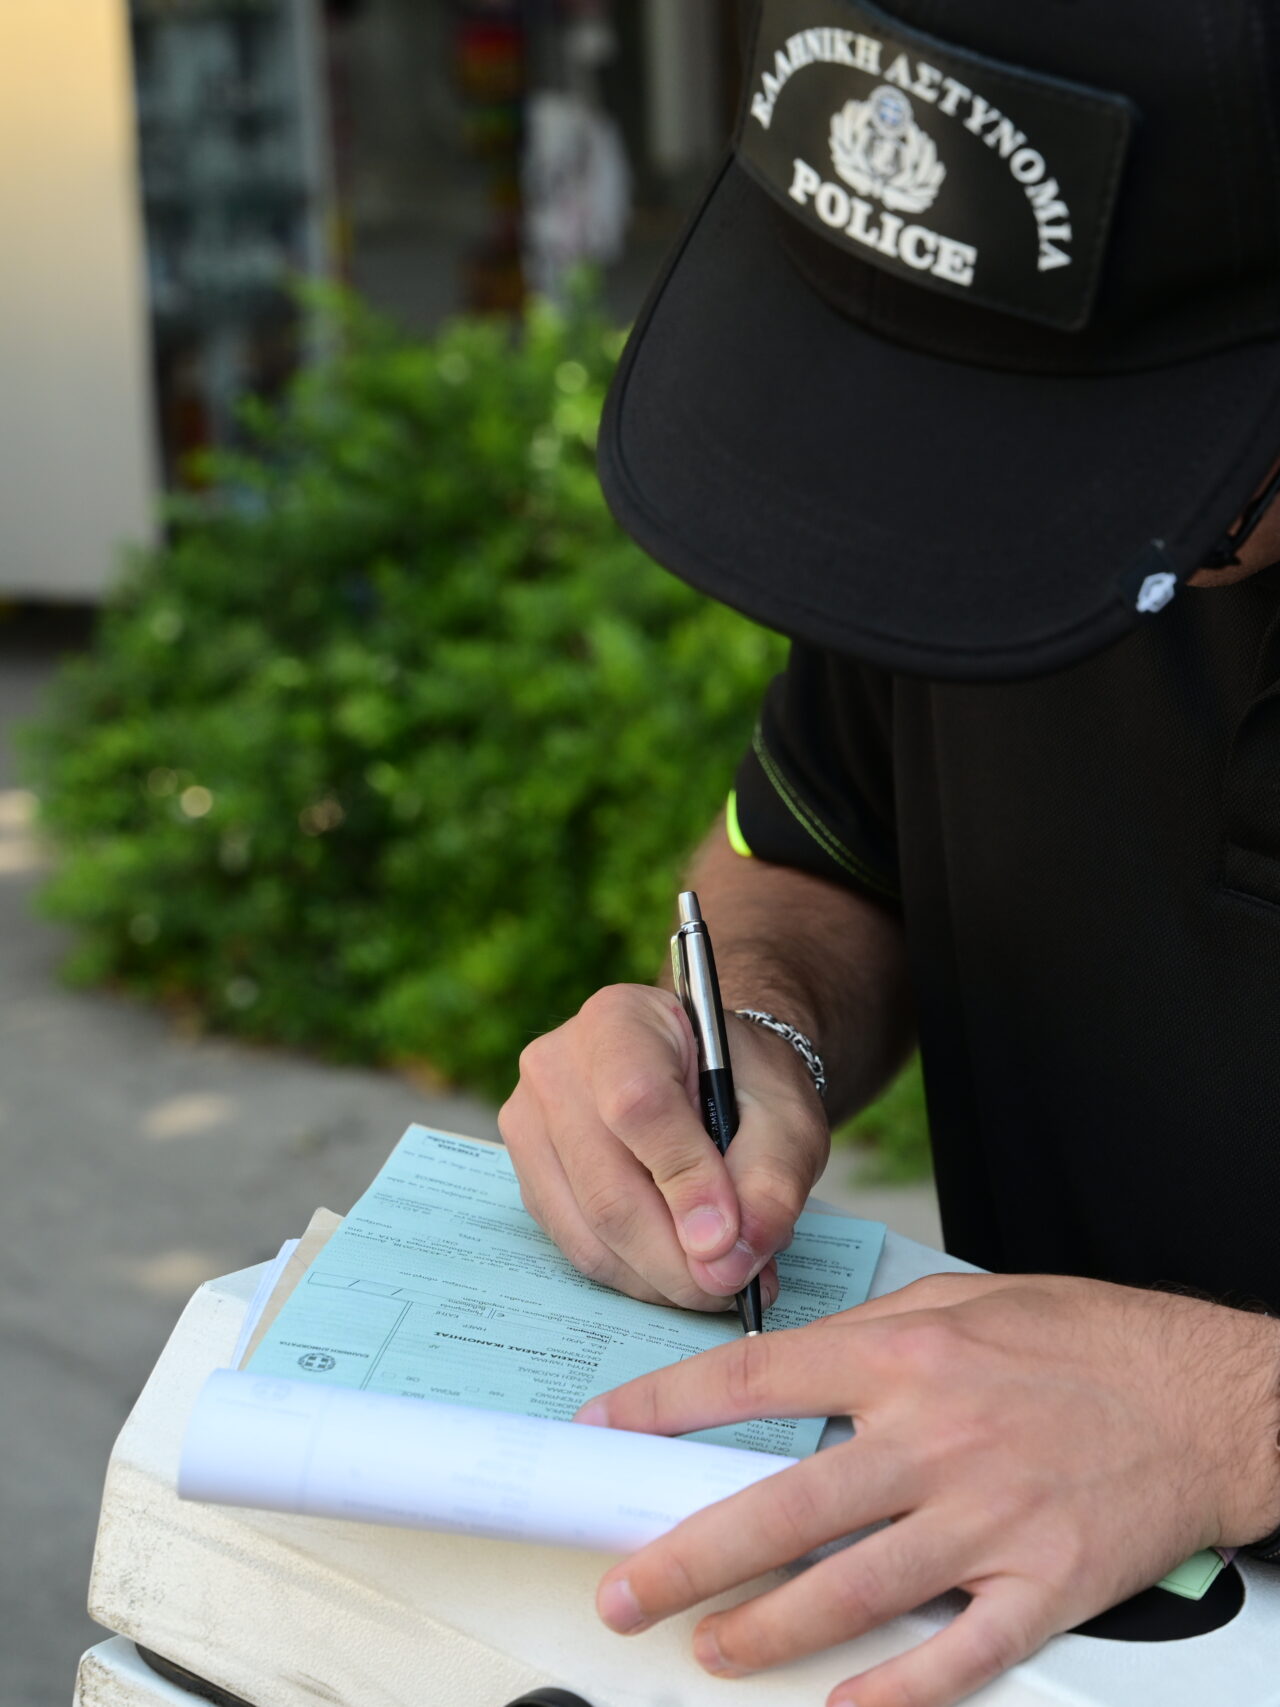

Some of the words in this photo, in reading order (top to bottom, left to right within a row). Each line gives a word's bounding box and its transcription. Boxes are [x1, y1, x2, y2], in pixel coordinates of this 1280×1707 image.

[751, 27, 883, 130] ΕΛΛΗΝΙΚΗ
[884, 53, 1073, 272] ΑΣΤΥΝΟΜΙΑ
[788, 157, 978, 287] POLICE
[277, 1339, 330, 1352] ΔΗΜΟΚΡΑΤΙΑ
[431, 1330, 505, 1348] ΙΚΑΝΟΤΗΤΑΣ
[329, 1348, 370, 1358] ΕΛΛΗΝΙΚΗ
[505, 1344, 547, 1357] ΑΔΕΙΑΣ
[548, 1353, 599, 1367] ΣΤΟΙΧΕΙΑ
